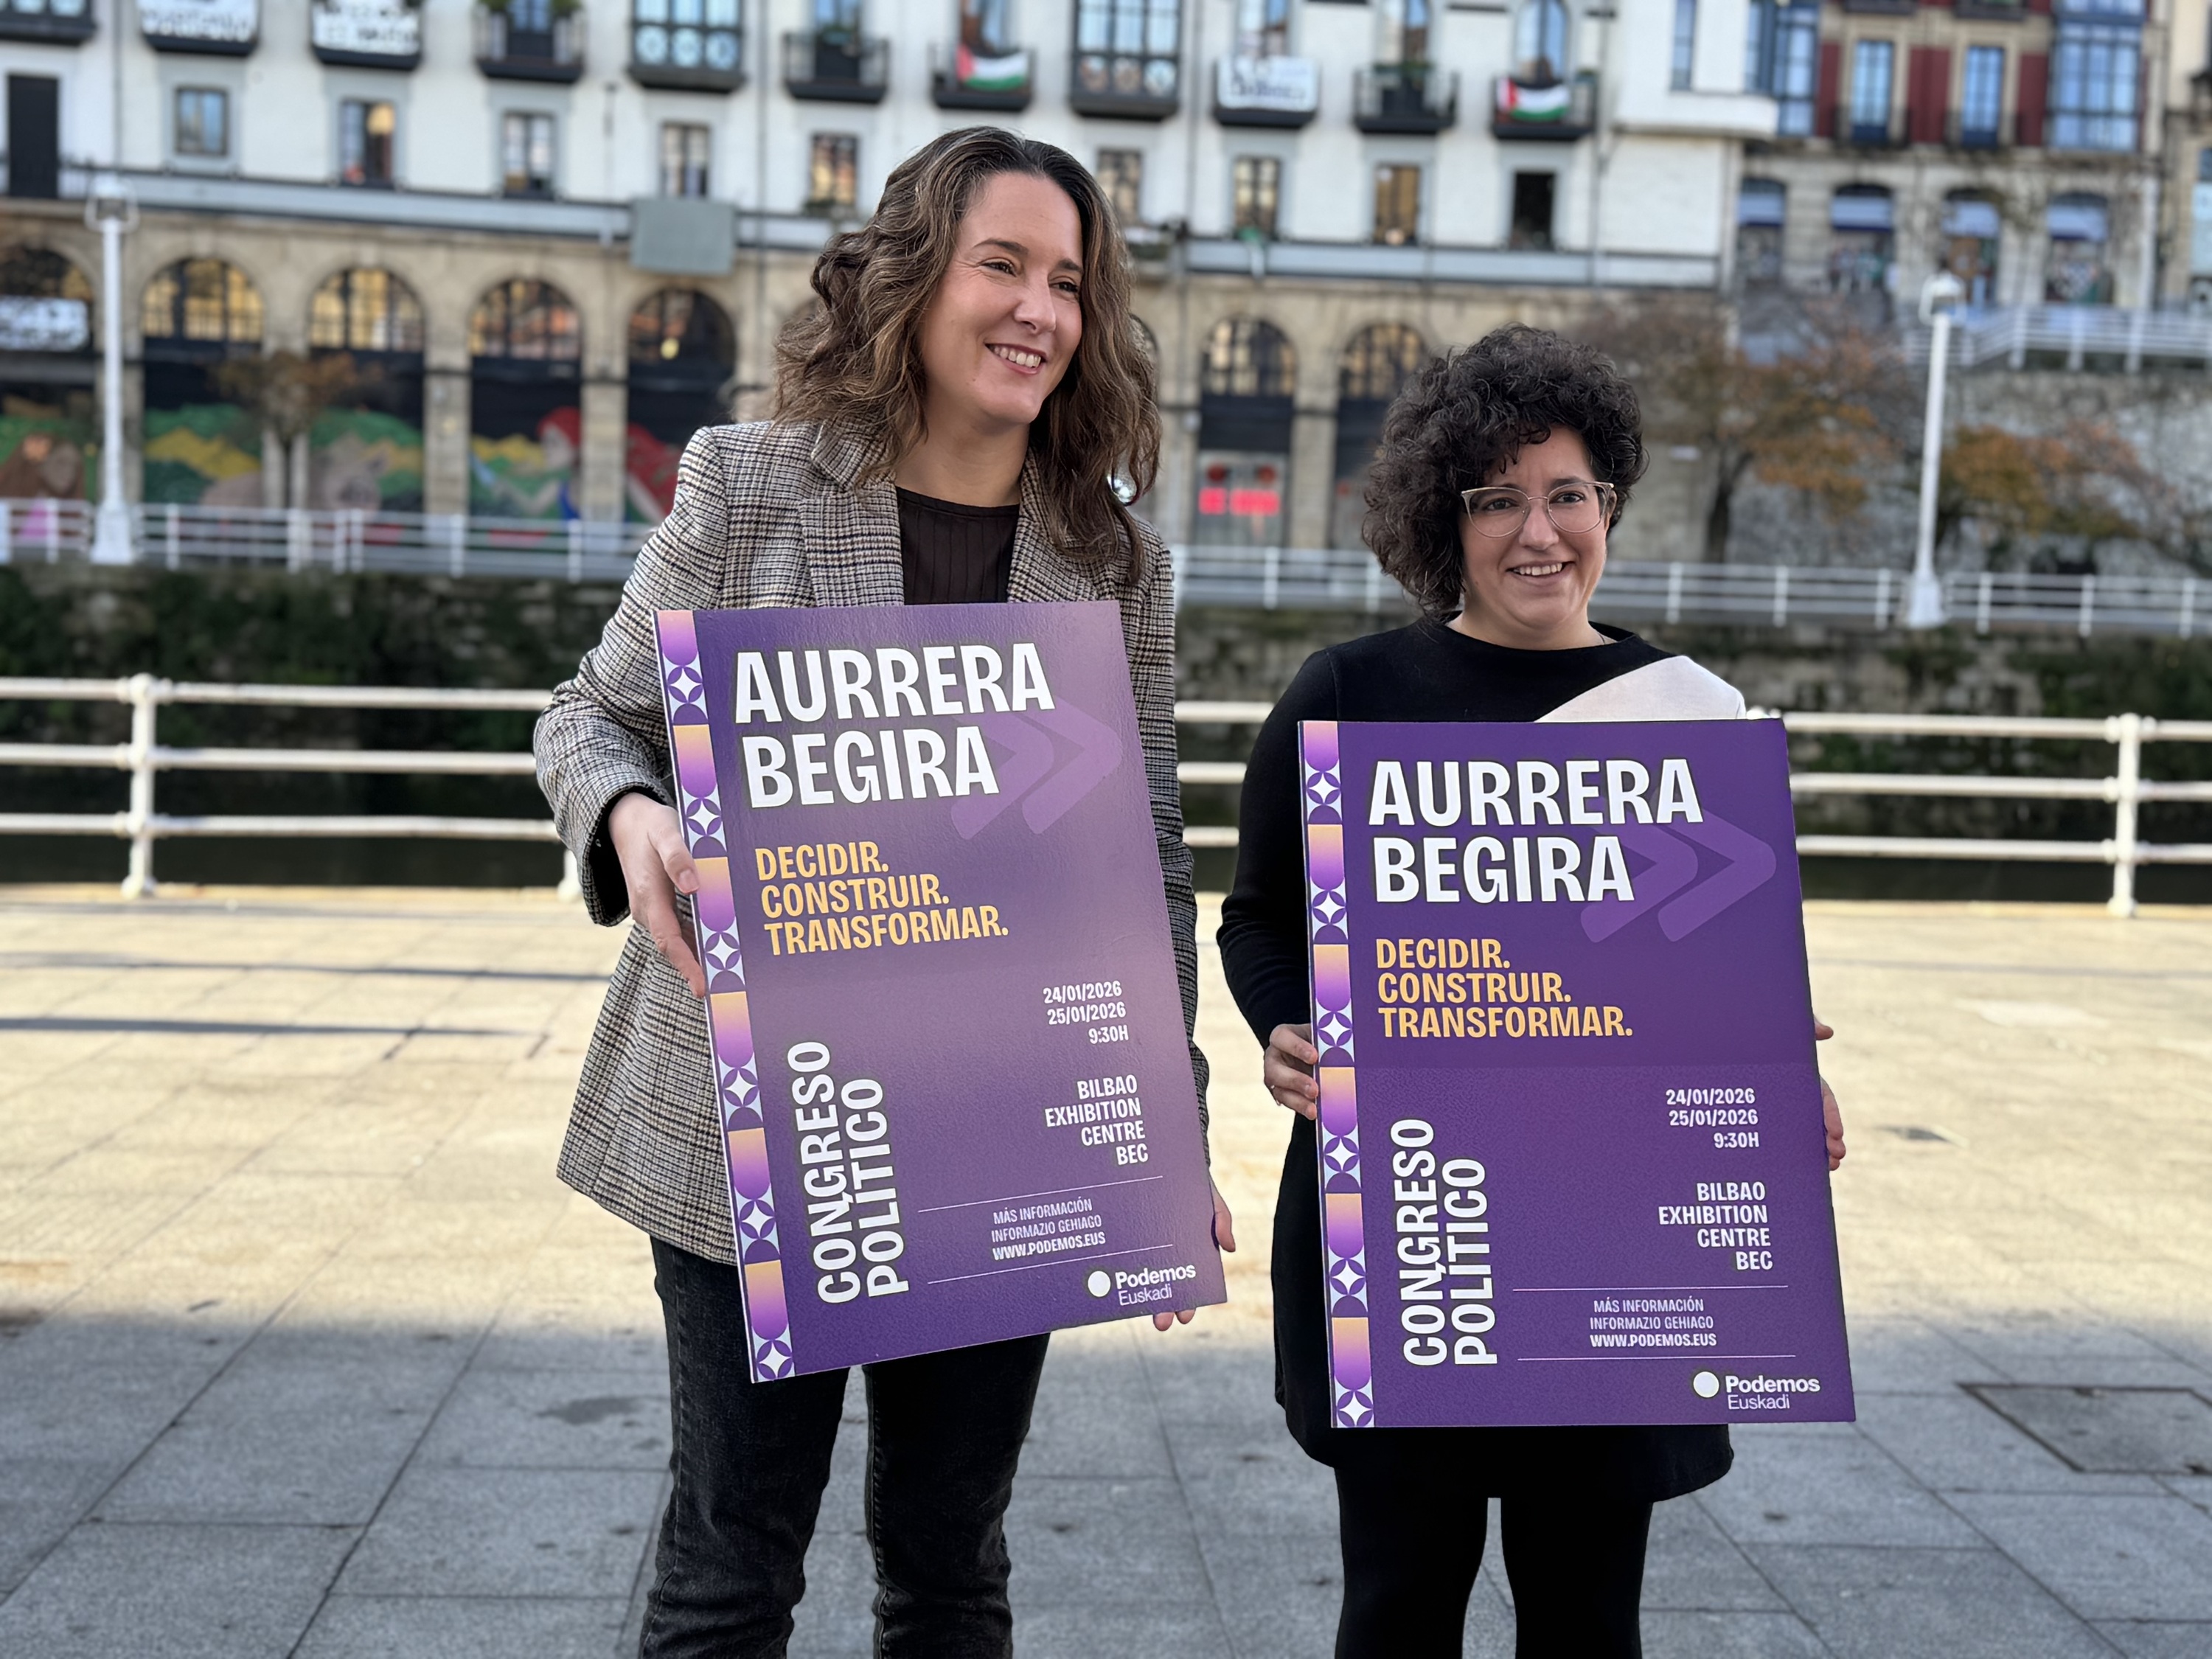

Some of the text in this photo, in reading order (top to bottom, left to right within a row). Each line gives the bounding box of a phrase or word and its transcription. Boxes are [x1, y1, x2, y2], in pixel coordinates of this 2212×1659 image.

[735, 642, 1055, 724] AURRERA
[742, 726, 999, 809] BEGIRA
[1368, 759, 1703, 827] AURRERA
[754, 841, 888, 881] DECIDIR.
[1373, 836, 1635, 903] BEGIRA
[761, 874, 949, 919] CONSTRUIR.
[764, 906, 1009, 956] TRANSFORMAR.
[1376, 939, 1510, 969] DECIDIR.
[1043, 981, 1122, 1004] 24/01/2026
[1378, 973, 1571, 1004] CONSTRUIR.
[1047, 1001, 1127, 1026] 25/01/2026
[1378, 1006, 1633, 1038] TRANSFORMAR.
[1088, 1025, 1129, 1044] 9:30H
[1077, 1074, 1138, 1099] BILBAO
[1666, 1088, 1756, 1107] 24/01/2026
[1045, 1099, 1141, 1127] EXHIBITION
[1669, 1109, 1759, 1127] 25/01/2026
[1081, 1121, 1146, 1146] CENTRE
[1714, 1132, 1759, 1149] 9:30H
[1116, 1145, 1148, 1166] BEC
[787, 1041, 860, 1303] CONGRESO
[1697, 1182, 1766, 1202] BILBAO
[993, 1197, 1092, 1225] MÁS INFORMACIÓN
[1658, 1205, 1768, 1225] EXHIBITION
[991, 1215, 1102, 1242] INFORMAZIO GEHIAGO
[1697, 1228, 1771, 1248] CENTRE
[992, 1231, 1105, 1260] WWW.PODEMOS.EUS
[1391, 1119, 1447, 1366] CONGRESO
[1736, 1251, 1773, 1270] BEC
[1115, 1263, 1196, 1287] Podemos
[1119, 1284, 1172, 1306] Euskadi
[1594, 1295, 1703, 1312] MÁS INFORMACIÓN
[1590, 1316, 1713, 1329] INFORMAZIO GEHIAGO
[1590, 1333, 1717, 1347] WWW.PODEMOS.EUS
[1725, 1375, 1820, 1393] Podemos
[1728, 1394, 1790, 1410] Euskadi
